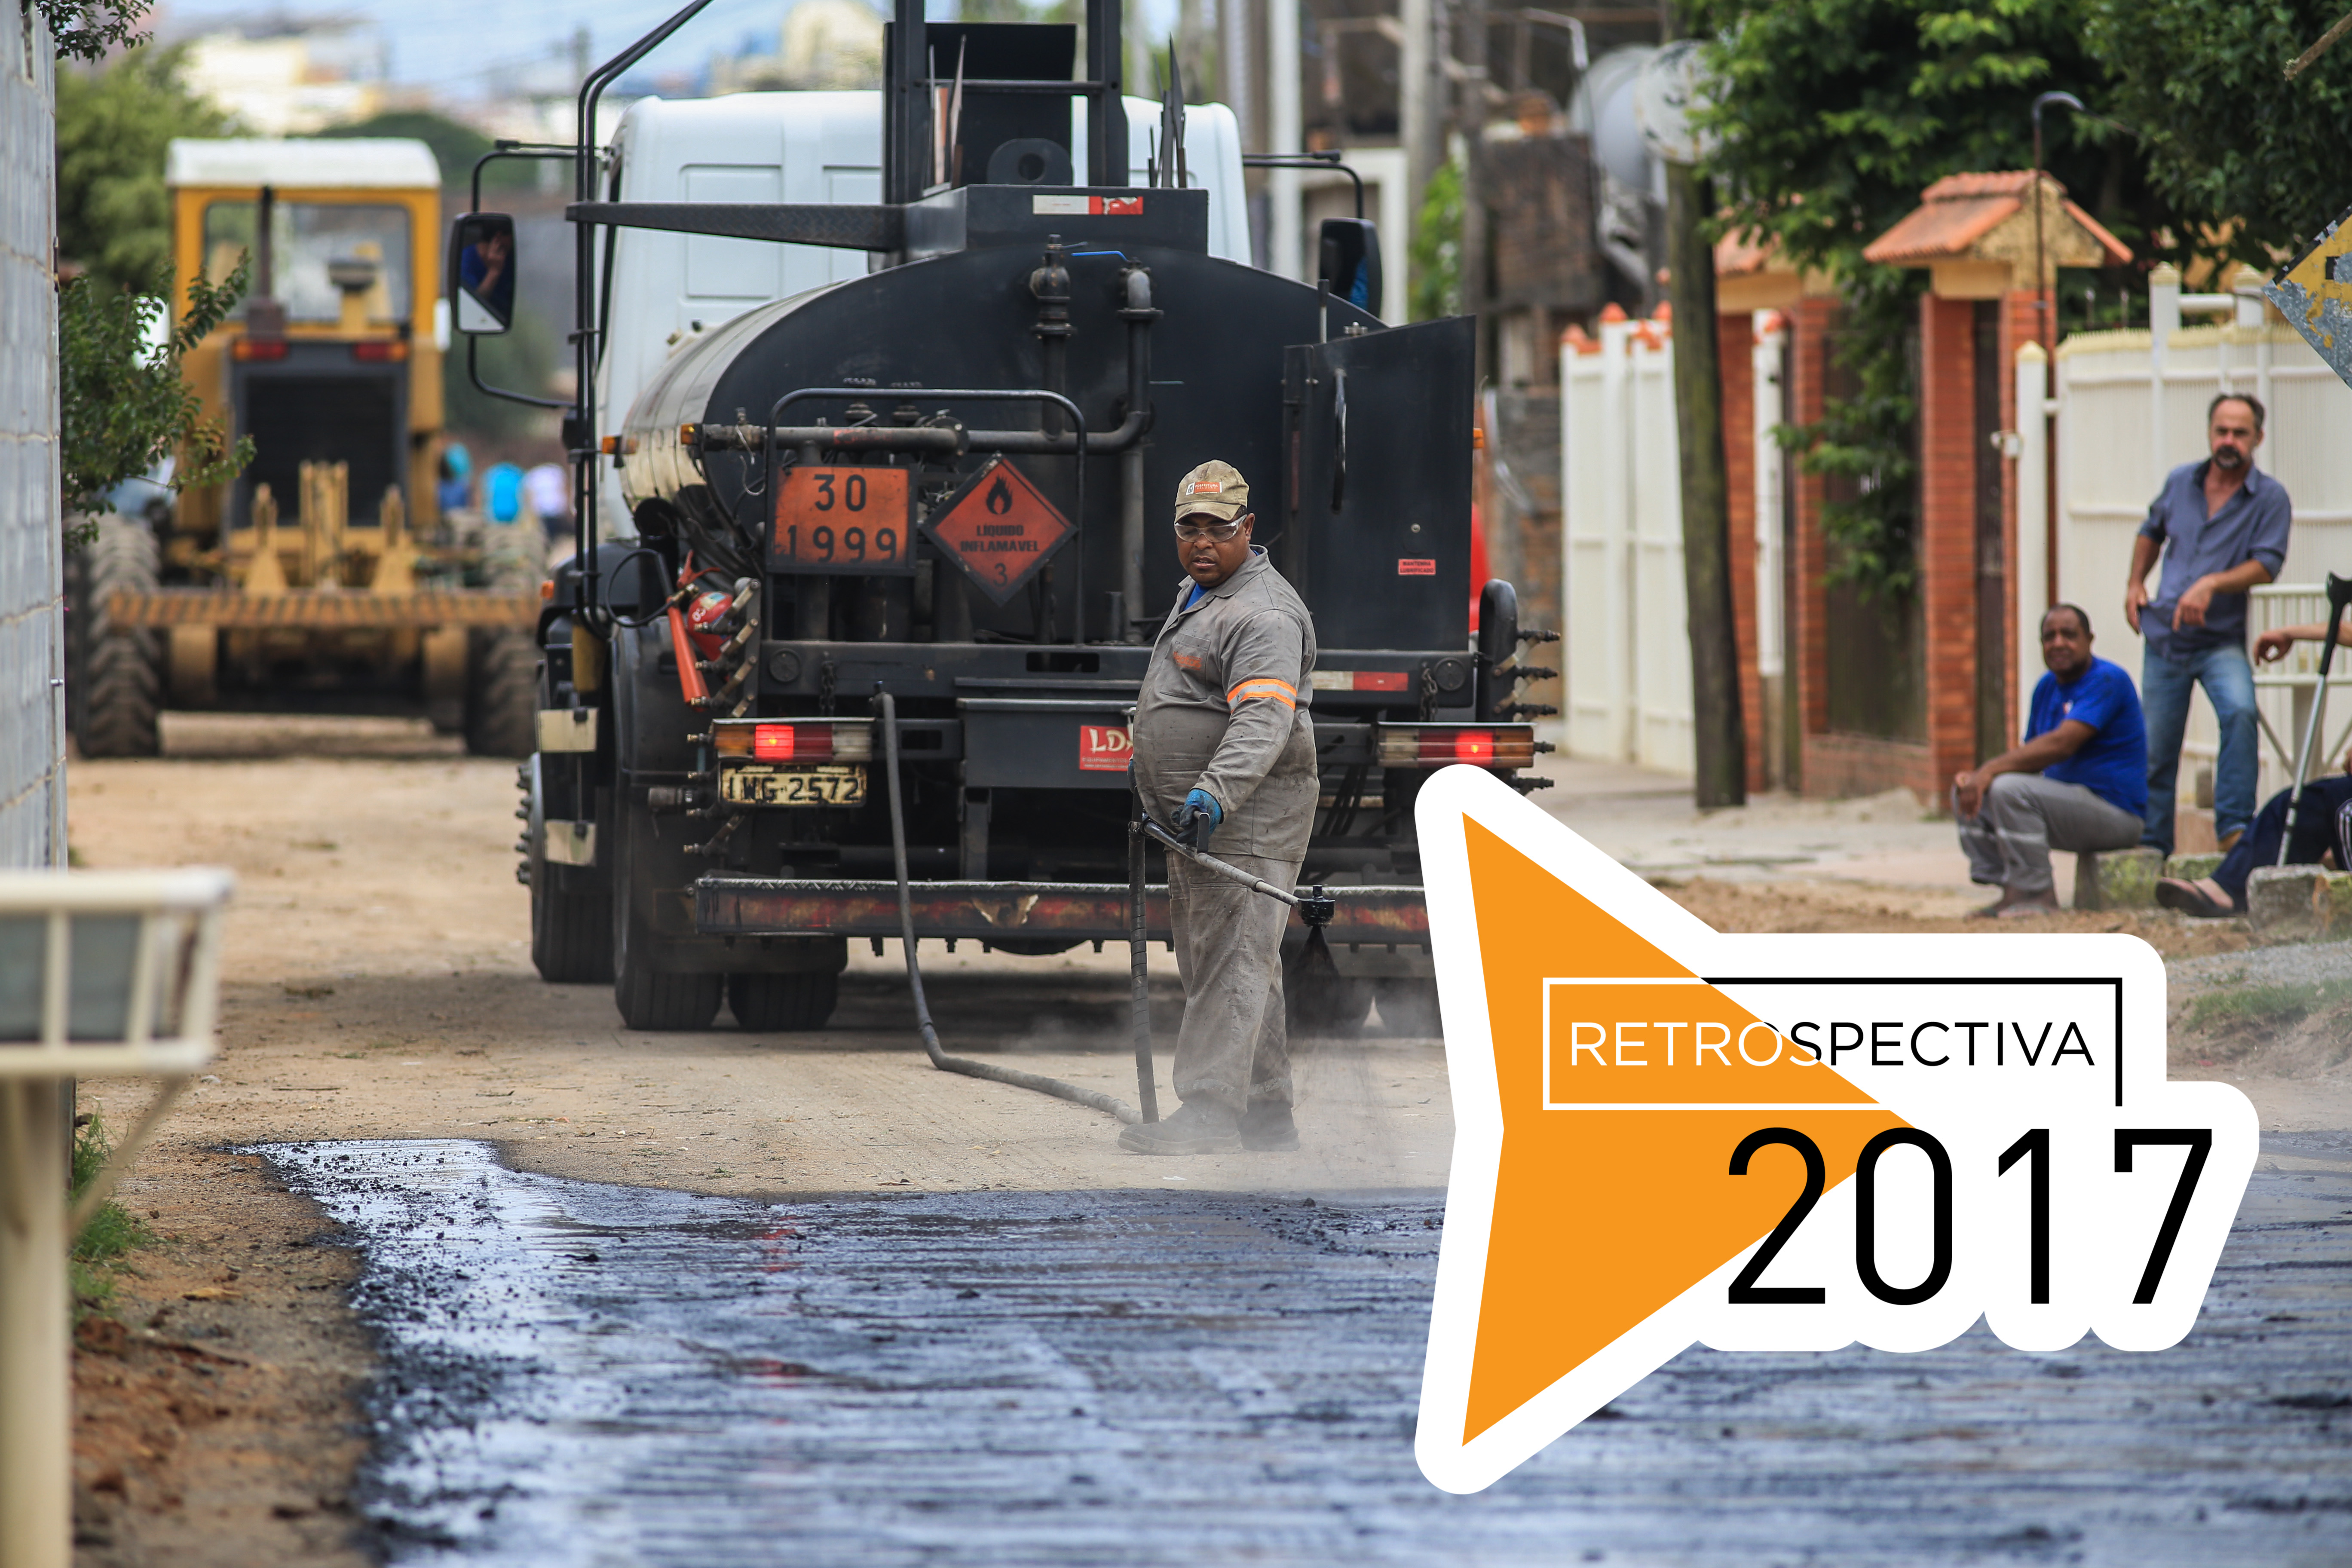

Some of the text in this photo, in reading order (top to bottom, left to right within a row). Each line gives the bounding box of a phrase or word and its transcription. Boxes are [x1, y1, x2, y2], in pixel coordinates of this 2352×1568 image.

[814, 474, 866, 511] 30
[787, 525, 897, 564] 1999
[961, 539, 1039, 551] INFLAMÁVEL
[993, 563, 1008, 587] 3
